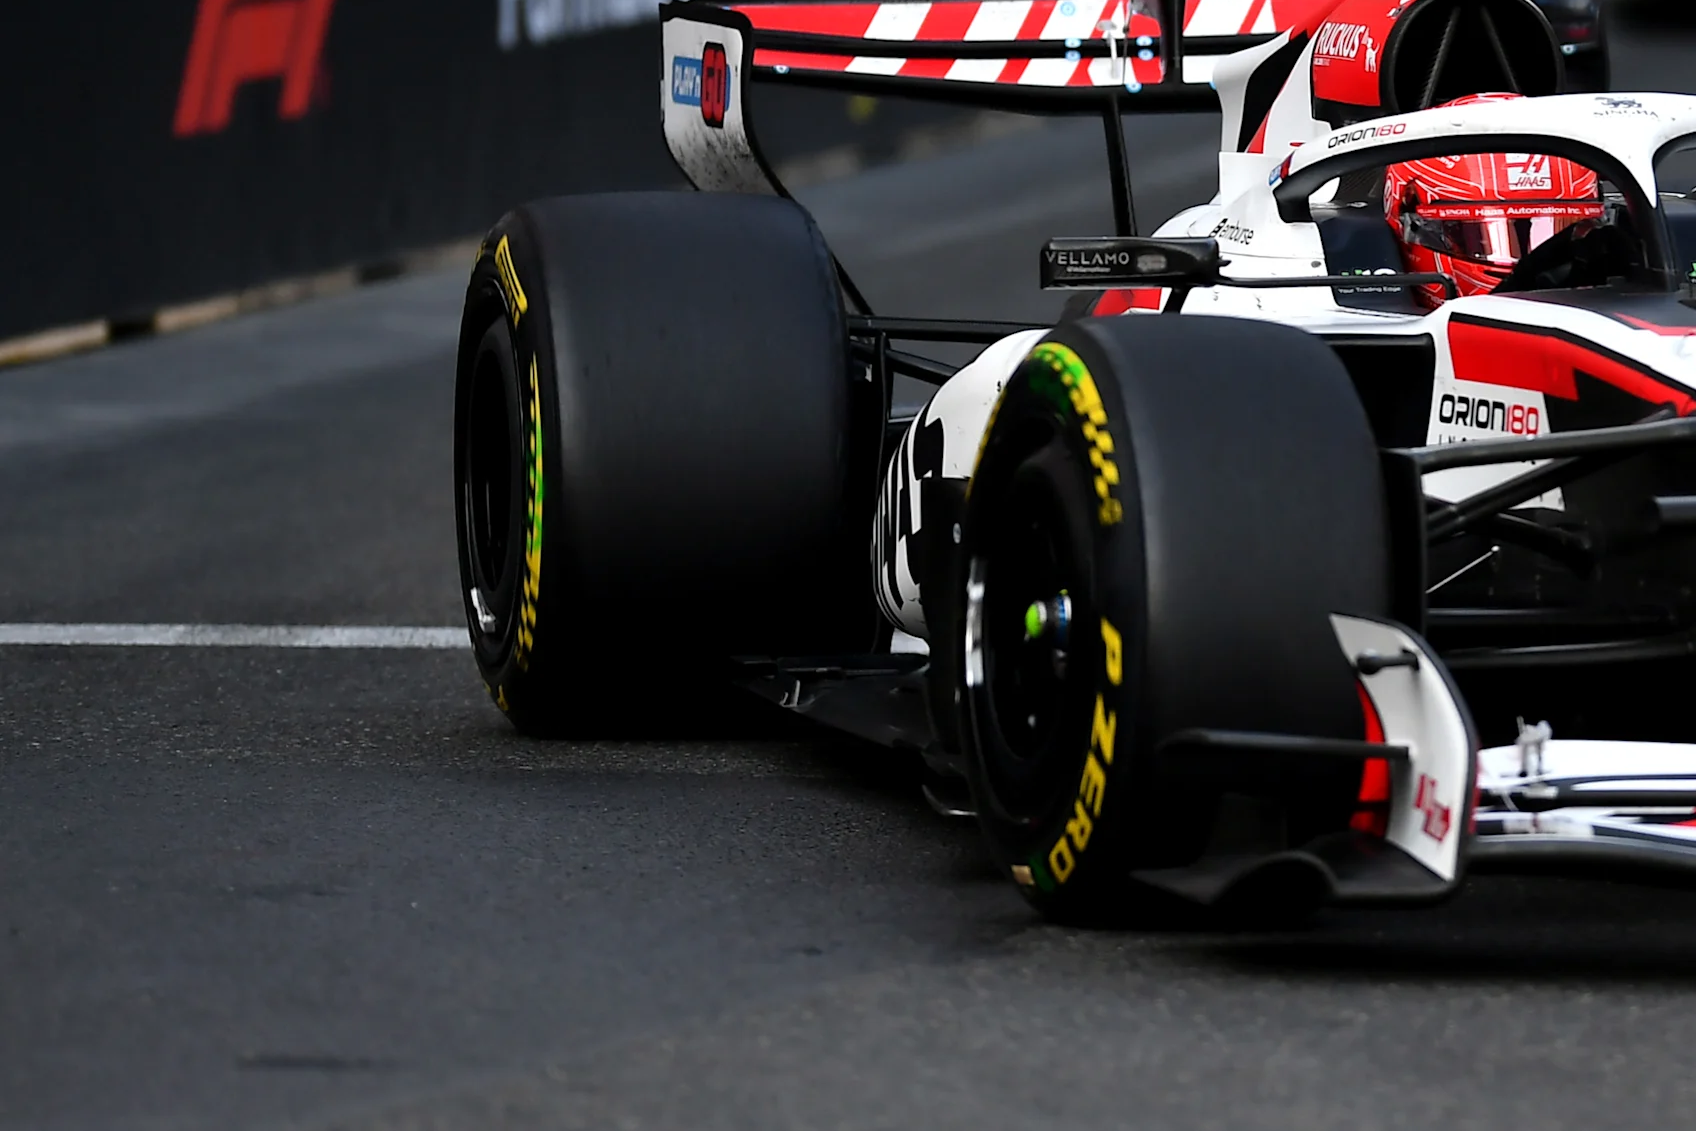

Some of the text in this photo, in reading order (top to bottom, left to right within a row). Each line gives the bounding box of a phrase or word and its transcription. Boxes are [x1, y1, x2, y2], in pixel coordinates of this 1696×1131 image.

[1315, 21, 1366, 59] RUCKUS
[1327, 122, 1407, 149] ORION180
[1506, 206, 1566, 215] Automation
[1567, 206, 1582, 215] Inc.
[1045, 251, 1130, 266] VELLAMO
[1438, 393, 1540, 436] ORION180
[1049, 616, 1123, 884] P ZERO
